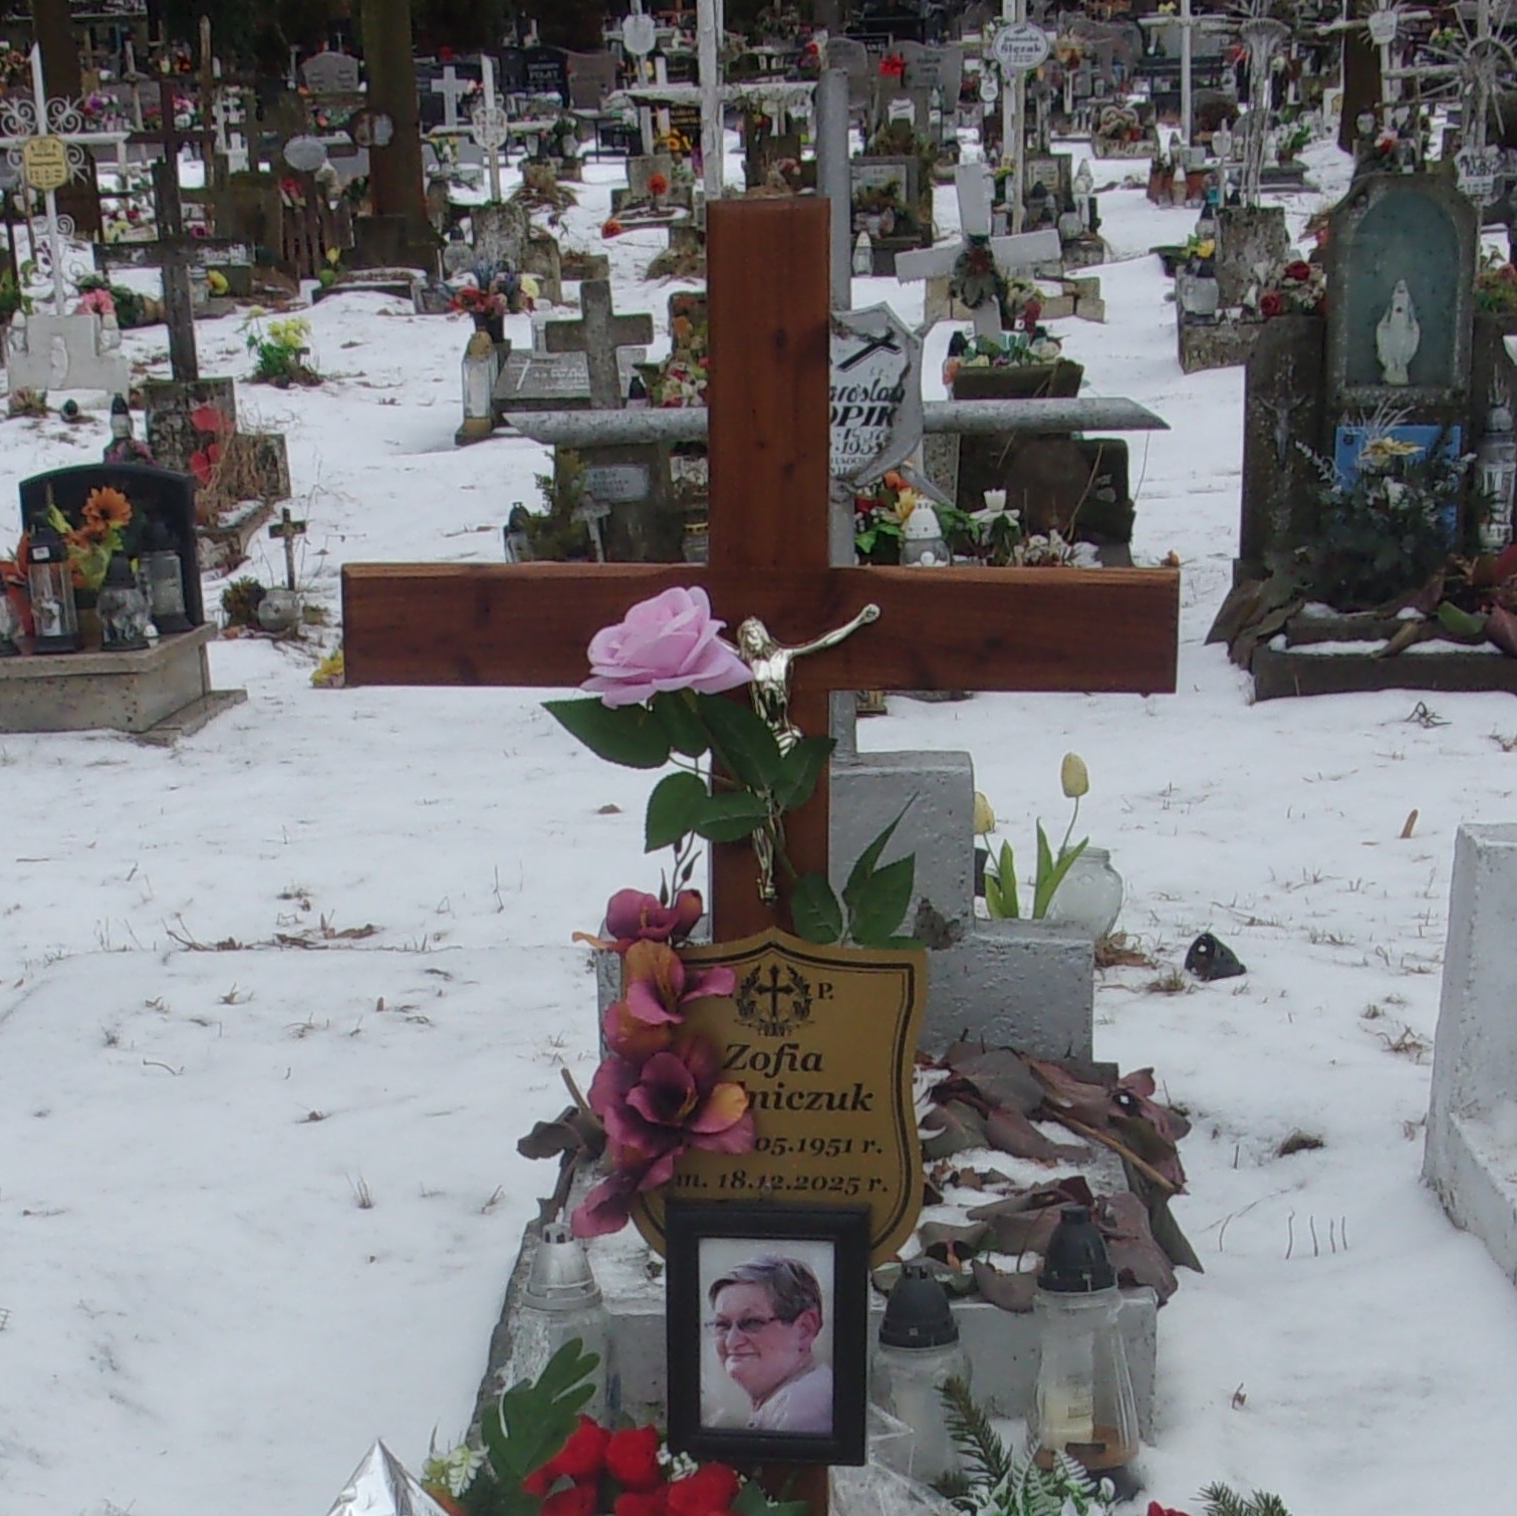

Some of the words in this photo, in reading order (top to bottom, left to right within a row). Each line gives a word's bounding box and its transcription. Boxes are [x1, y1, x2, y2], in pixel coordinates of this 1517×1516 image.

[818, 982, 834, 1000] P.
[724, 1043, 823, 1079] Zofia
[742, 1082, 874, 1112] niczuk
[755, 1137, 852, 1156] 05.1951
[862, 1140, 883, 1154] r.
[676, 1173, 708, 1188] m.
[718, 1170, 860, 1195] 18.12.2025
[868, 1177, 888, 1193] r.
